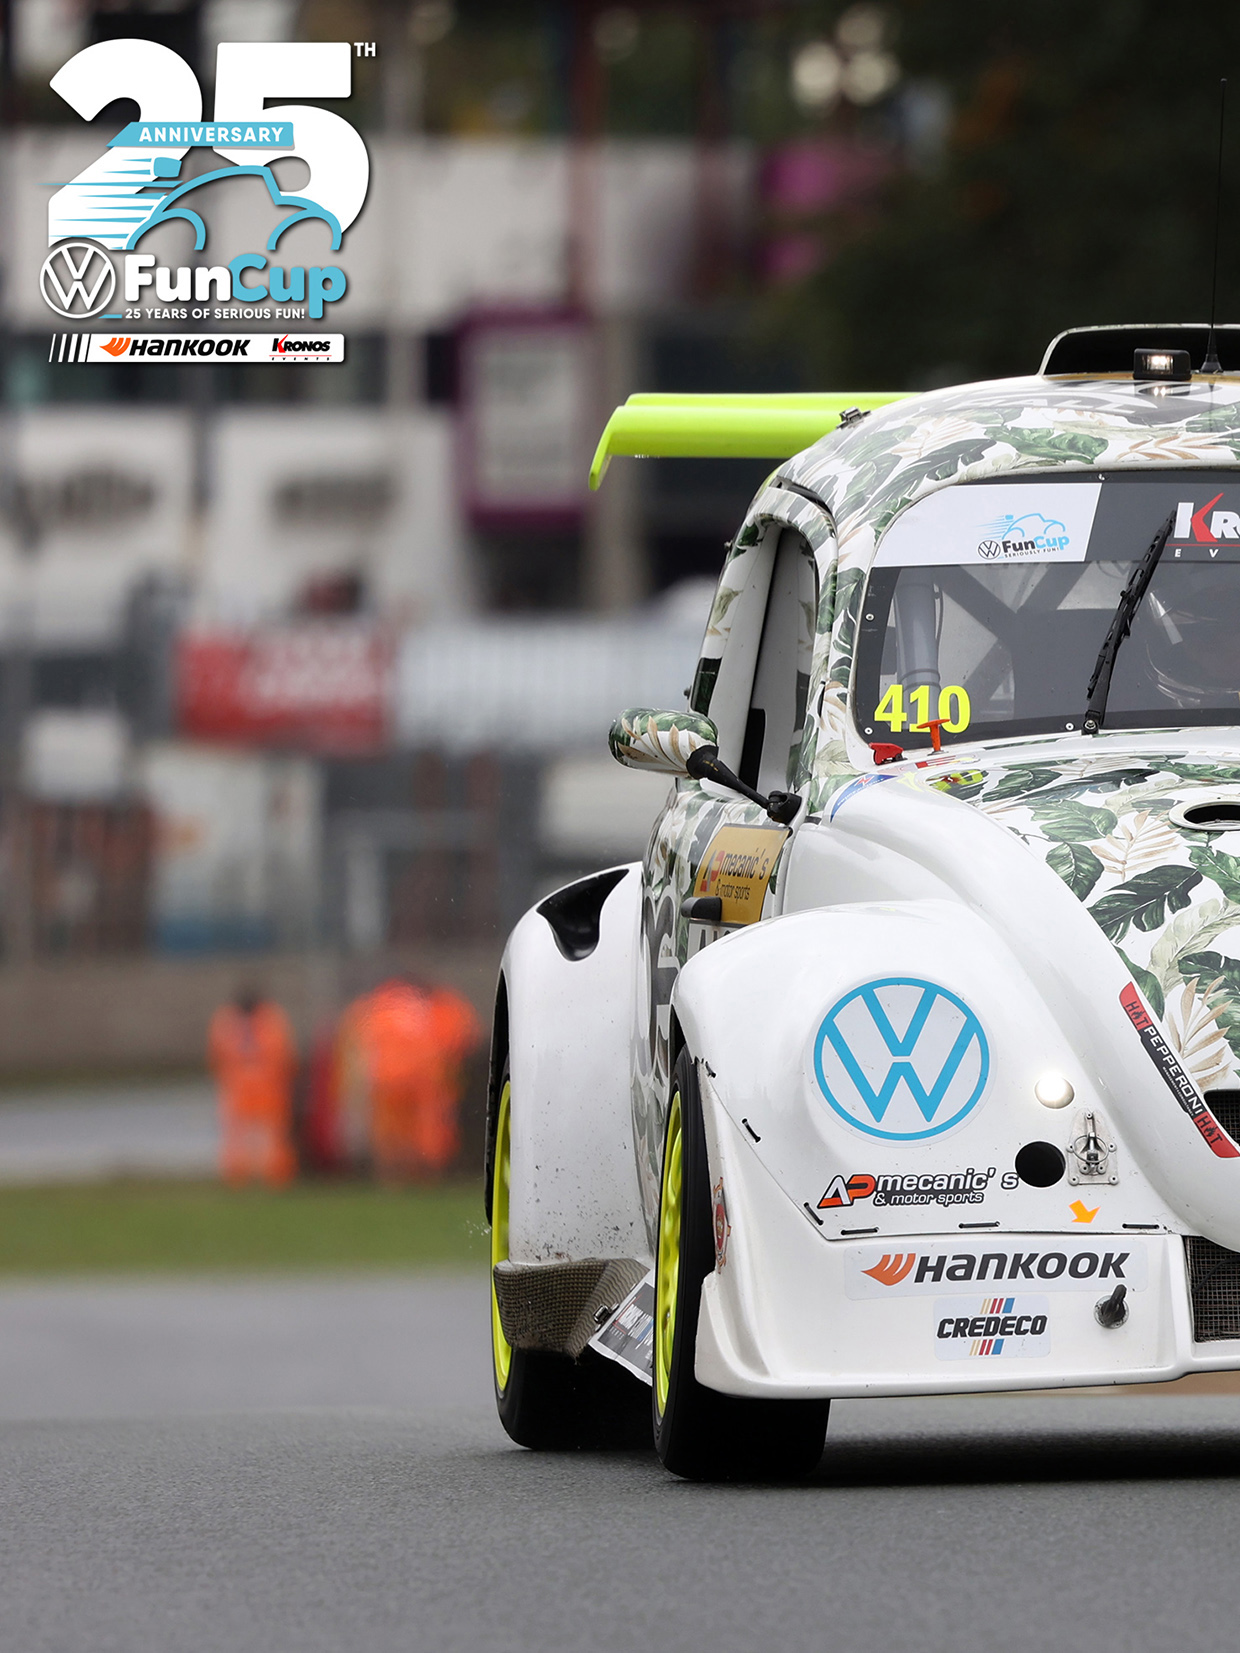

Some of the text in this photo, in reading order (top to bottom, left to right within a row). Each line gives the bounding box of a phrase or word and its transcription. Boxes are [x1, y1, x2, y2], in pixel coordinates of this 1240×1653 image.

[874, 684, 971, 733] 410
[1144, 1025, 1204, 1114] PEPPERONI
[891, 1192, 935, 1206] motor
[937, 1191, 984, 1207] sports
[937, 1314, 1048, 1339] CREDECO
